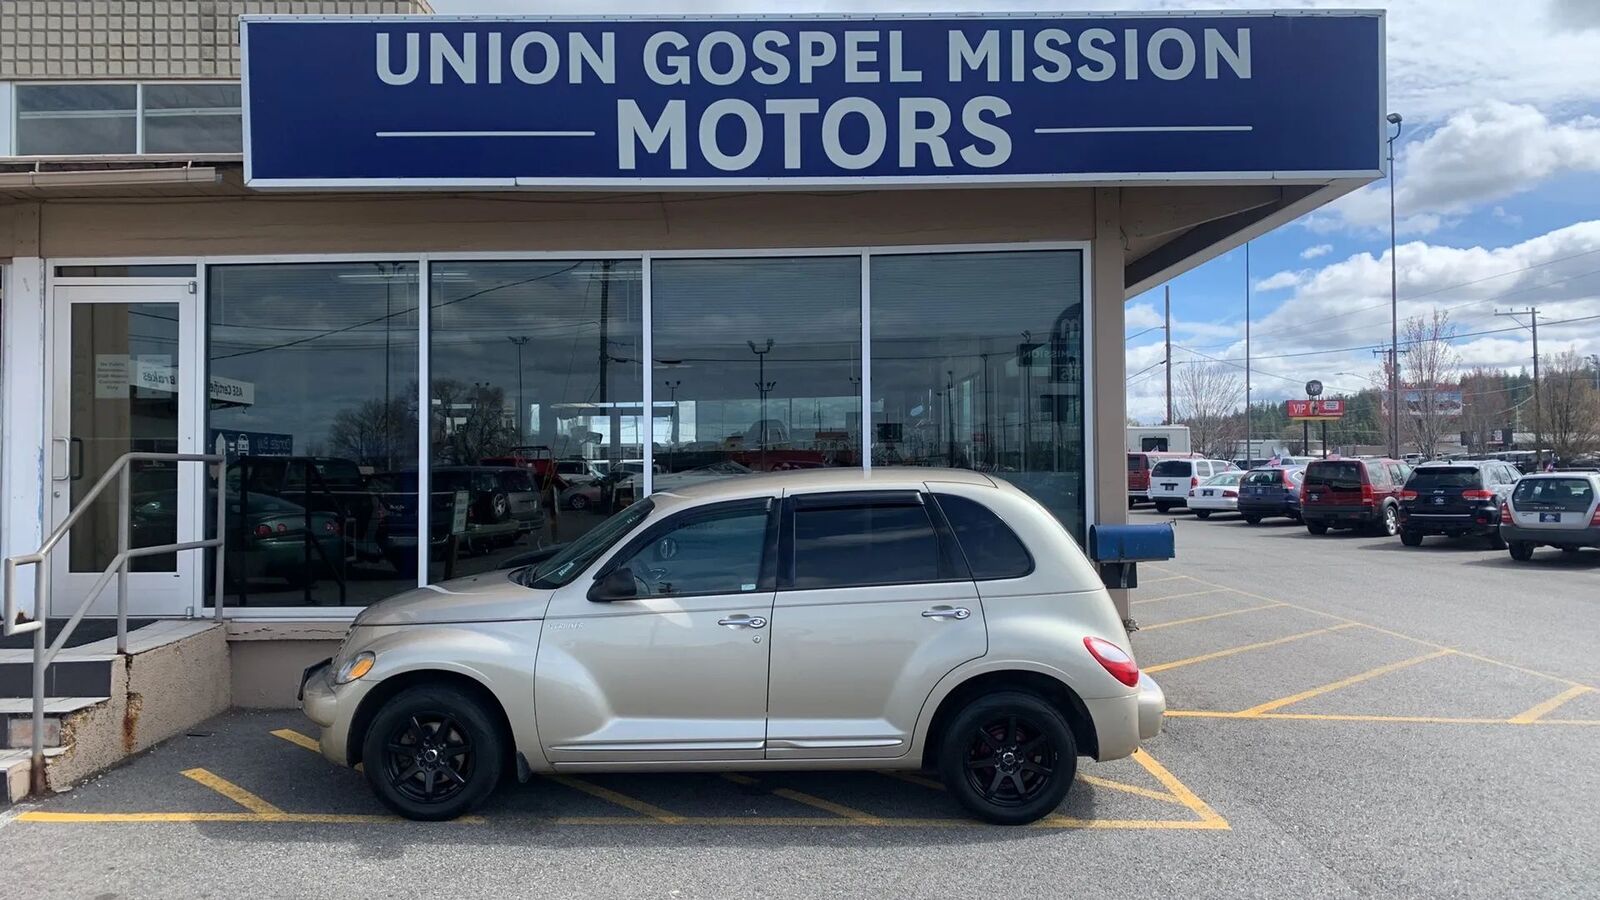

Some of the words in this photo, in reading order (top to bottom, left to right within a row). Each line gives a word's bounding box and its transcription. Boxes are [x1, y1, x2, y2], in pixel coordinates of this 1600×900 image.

[376, 32, 616, 86] UNION
[643, 30, 922, 86] GOSPEL
[948, 28, 1252, 82] MISSION
[617, 96, 1012, 171] MOTORS
[1293, 404, 1307, 414] VIP
